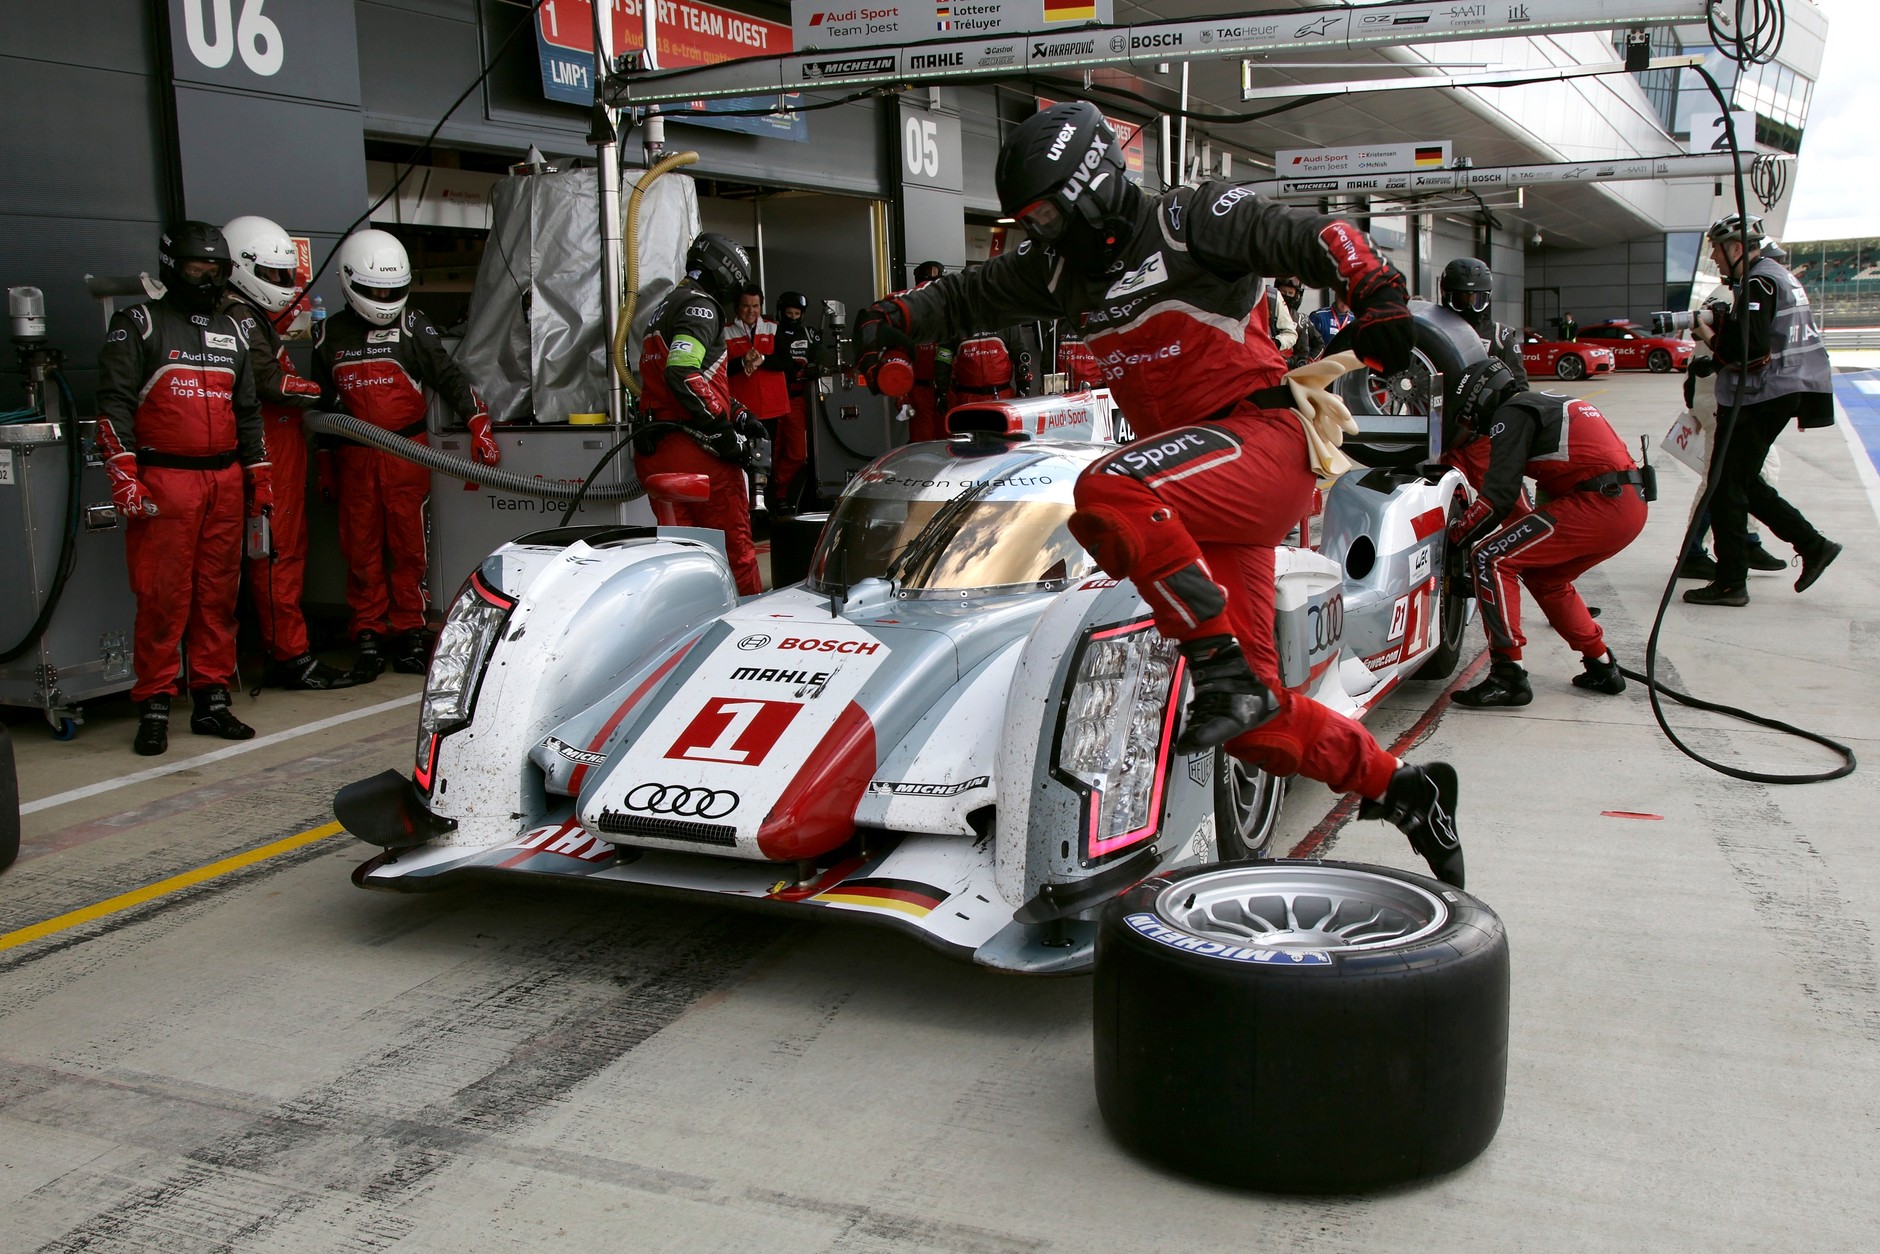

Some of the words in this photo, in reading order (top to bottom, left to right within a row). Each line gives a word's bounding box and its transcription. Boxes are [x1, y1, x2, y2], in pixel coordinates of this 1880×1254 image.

[827, 10, 858, 23] Audi
[861, 8, 898, 22] Sport
[954, 5, 1001, 16] Lotterer
[1450, 4, 1486, 18] SAATI
[1508, 3, 1530, 19] itk
[625, 0, 677, 26] SPRT
[680, 5, 724, 38] TEAM
[727, 18, 768, 49] JOEST
[827, 26, 862, 38] Team
[865, 23, 898, 35] Joest
[954, 19, 1001, 31] Tréluyer
[1450, 18, 1486, 27] Composites
[183, 0, 284, 76] 06
[624, 29, 644, 47] Aud
[1131, 33, 1183, 49] BOSCH
[991, 45, 1014, 55] Castrol
[823, 58, 893, 73] MICHELIN
[911, 52, 963, 69] MAHLE
[551, 60, 588, 88] LMP1
[905, 117, 939, 178] 05
[1046, 123, 1077, 161] uvex
[1303, 155, 1323, 163] Audi
[1325, 154, 1349, 163] Sport
[1327, 163, 1348, 171] Joest
[1061, 134, 1110, 202] uvex
[1297, 182, 1337, 190] MICHELIN
[1347, 180, 1378, 189] MAHLE
[1472, 174, 1501, 183] BOSCH
[160, 252, 176, 269] vex
[735, 247, 749, 267] uvex
[722, 255, 747, 287] uvex
[181, 352, 206, 362] Audi
[207, 353, 234, 364] Sport
[367, 347, 392, 355] Sport
[1524, 353, 1541, 361] trol
[1609, 346, 1635, 355] Track
[170, 377, 198, 388] Audi
[356, 377, 395, 388] Service
[1456, 373, 1471, 395] uvex
[170, 387, 195, 398] Top
[196, 388, 233, 401] Service
[1463, 374, 1490, 414] uvex
[1048, 410, 1067, 428] Audi
[1068, 409, 1088, 429] Sport
[1676, 425, 1693, 451] 24
[1123, 432, 1206, 470] Sport
[884, 475, 950, 488] e-tron
[959, 475, 1053, 488] quattro
[487, 495, 535, 511] Team
[539, 498, 585, 514] Joet
[1477, 549, 1490, 583] Audi
[1488, 524, 1533, 554] Sport
[1391, 602, 1406, 635] P1
[1408, 590, 1422, 655] 1
[777, 637, 881, 656] BOSCH
[729, 666, 830, 685] MAHLE
[682, 702, 766, 763] 1
[561, 747, 606, 764] MICHE
[895, 776, 987, 795] MICHELIN
[1128, 914, 1275, 962] MICHELIN
